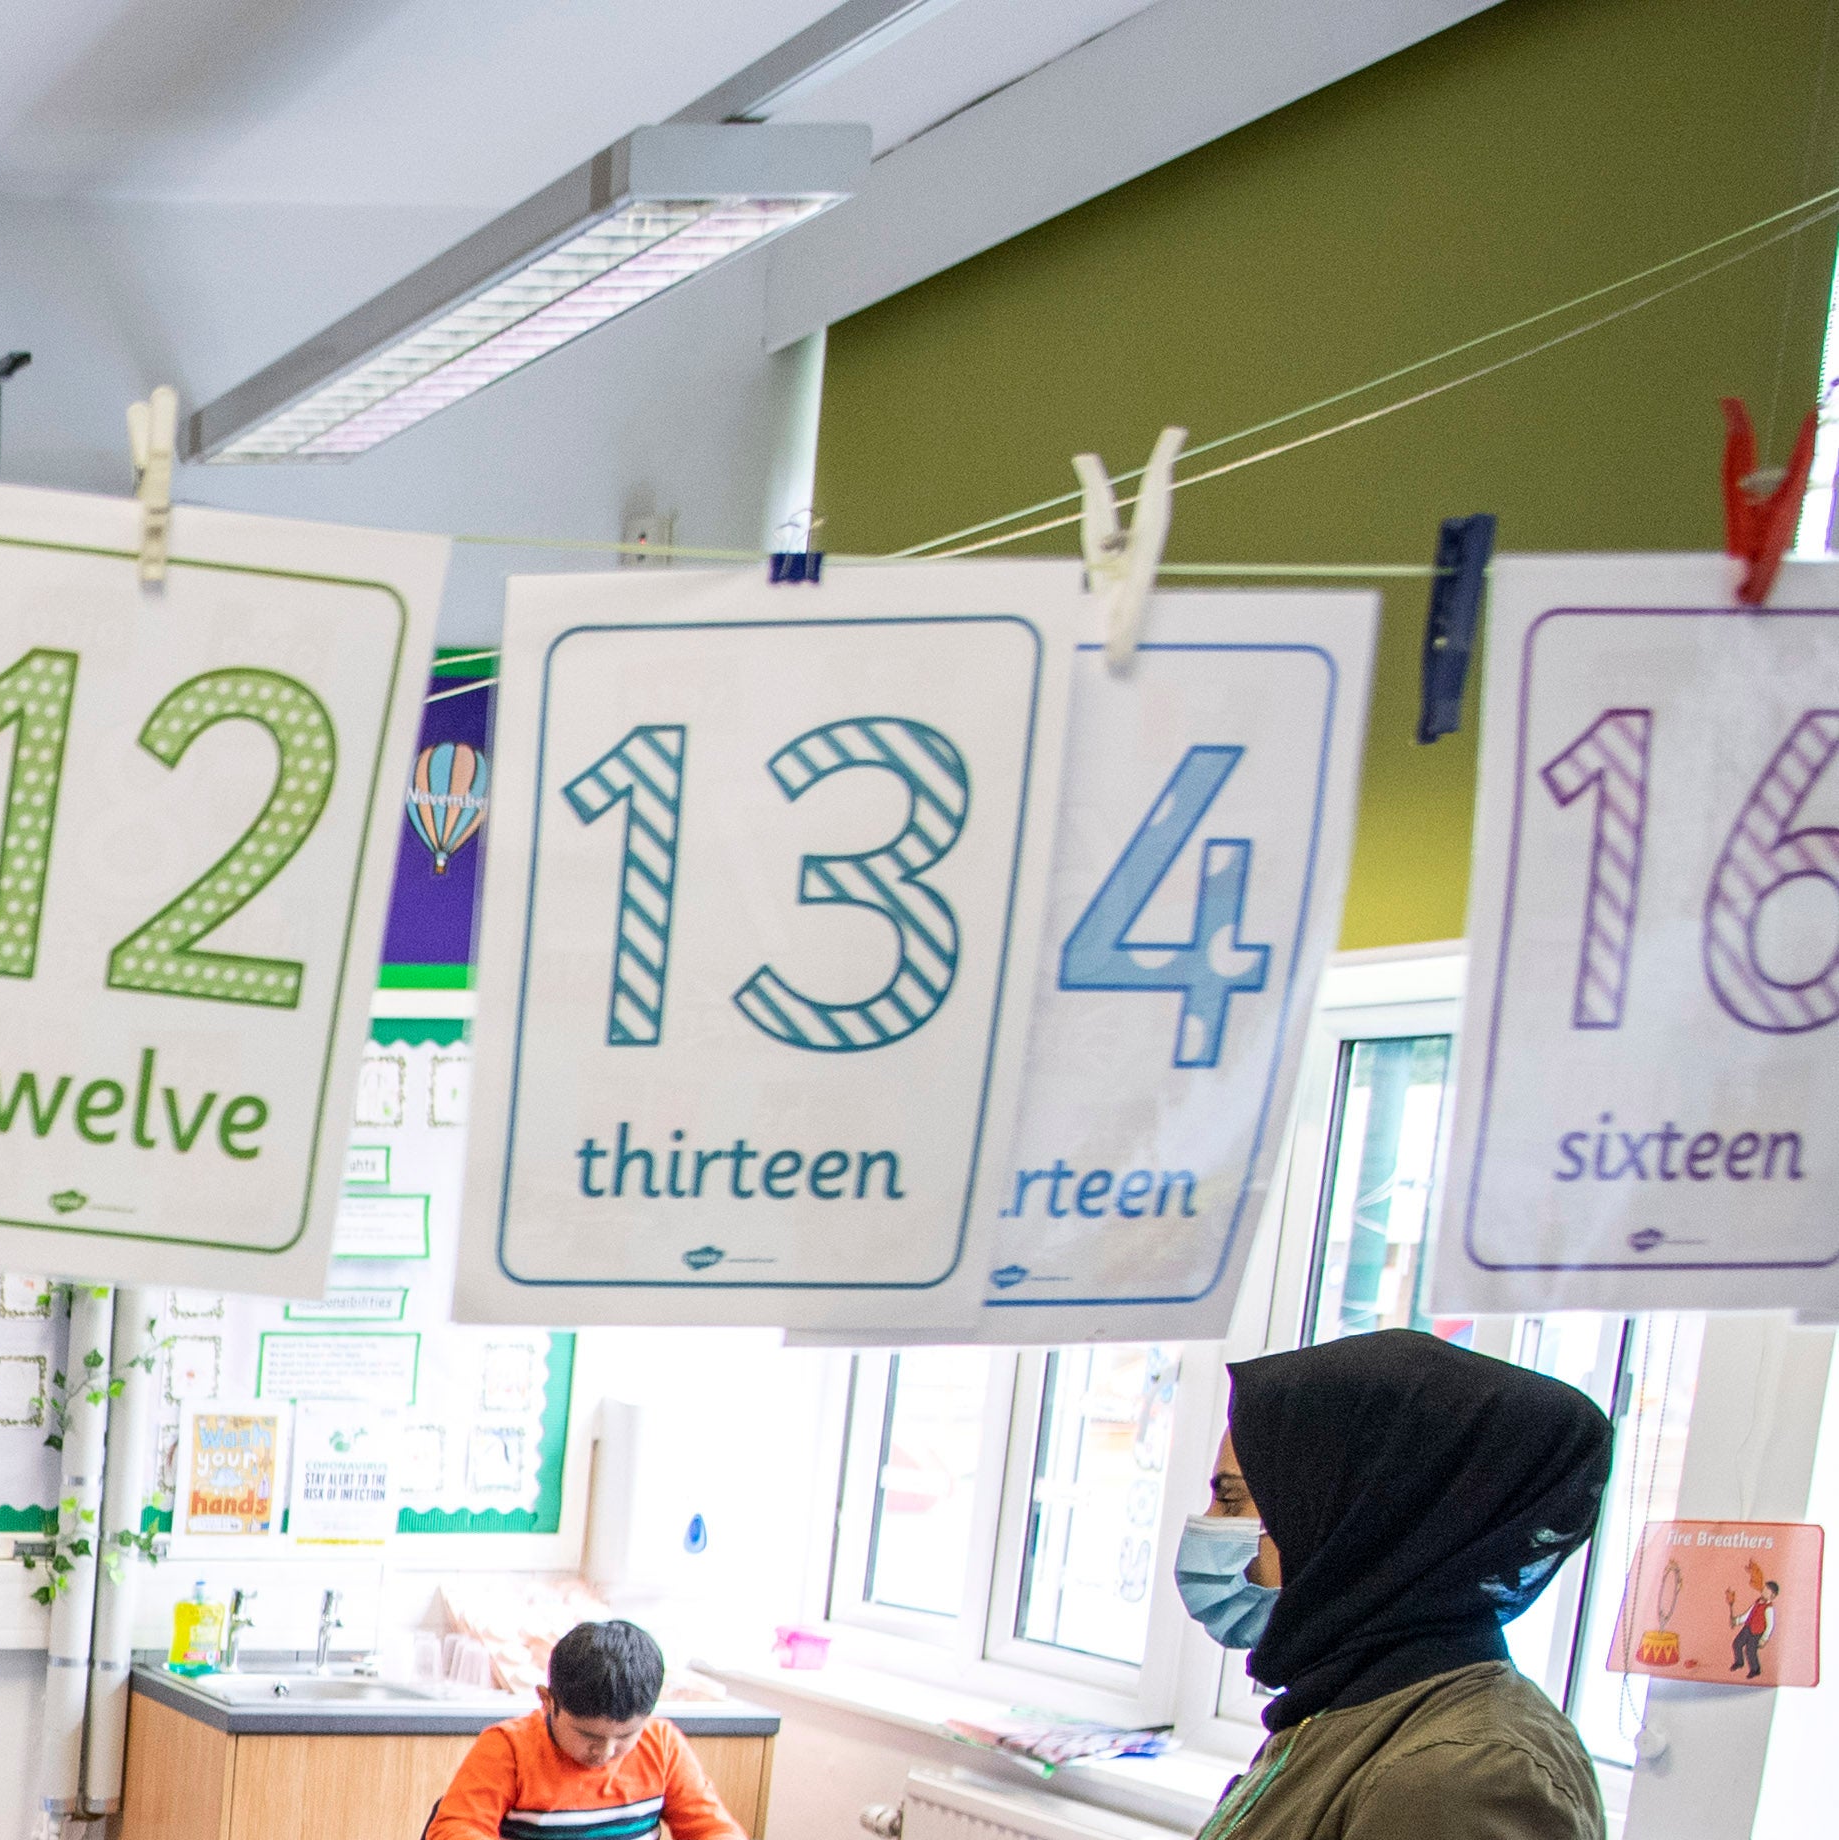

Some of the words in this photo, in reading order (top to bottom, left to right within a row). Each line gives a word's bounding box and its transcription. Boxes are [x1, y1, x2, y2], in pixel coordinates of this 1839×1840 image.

[561, 716, 970, 1052] 13
[1540, 707, 1839, 1034] 16
[1059, 744, 1272, 1069] 4
[575, 1122, 903, 1200] thirteen
[1553, 1113, 1805, 1182] sixteen
[1011, 1158, 1197, 1218] rteen
[199, 1421, 271, 1450] Wash
[197, 1451, 257, 1477] your
[305, 1473, 326, 1484] STAY
[329, 1473, 355, 1485] ALERT
[358, 1473, 368, 1485] TO
[371, 1473, 386, 1485] THE
[191, 1489, 268, 1515] hands
[304, 1488, 323, 1500] RISK
[327, 1488, 337, 1500] OF
[340, 1488, 386, 1501] INFECTION
[1666, 1530, 1692, 1546] Fire
[1697, 1530, 1775, 1549] Breathers
